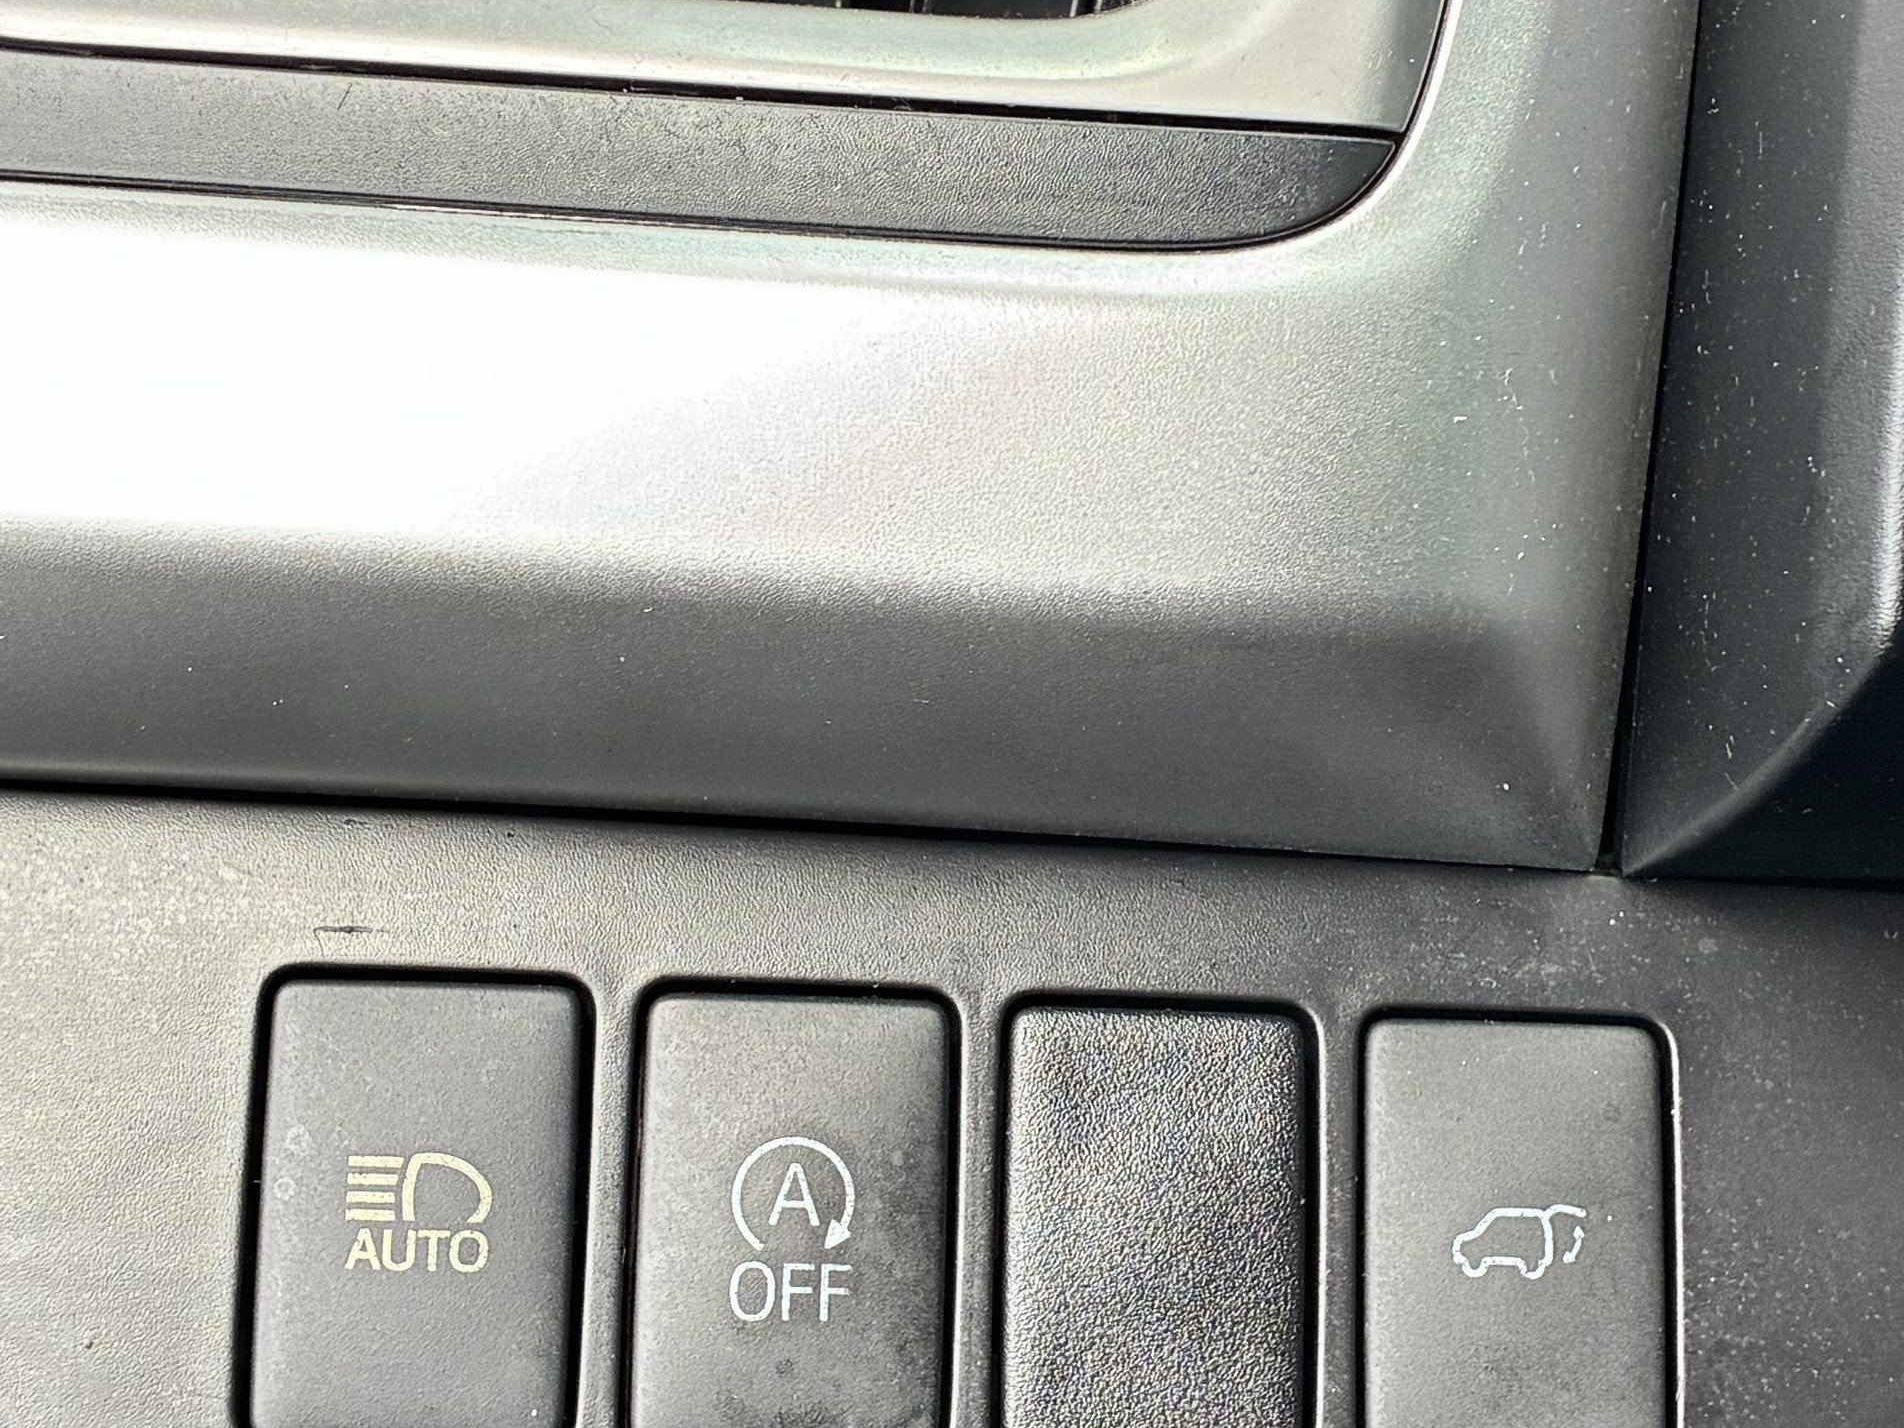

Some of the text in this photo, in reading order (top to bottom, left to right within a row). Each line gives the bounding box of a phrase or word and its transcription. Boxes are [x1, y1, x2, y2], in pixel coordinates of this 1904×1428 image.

[768, 1163, 820, 1227] A
[345, 1227, 490, 1272] AUTO
[728, 1260, 853, 1322] OFF
